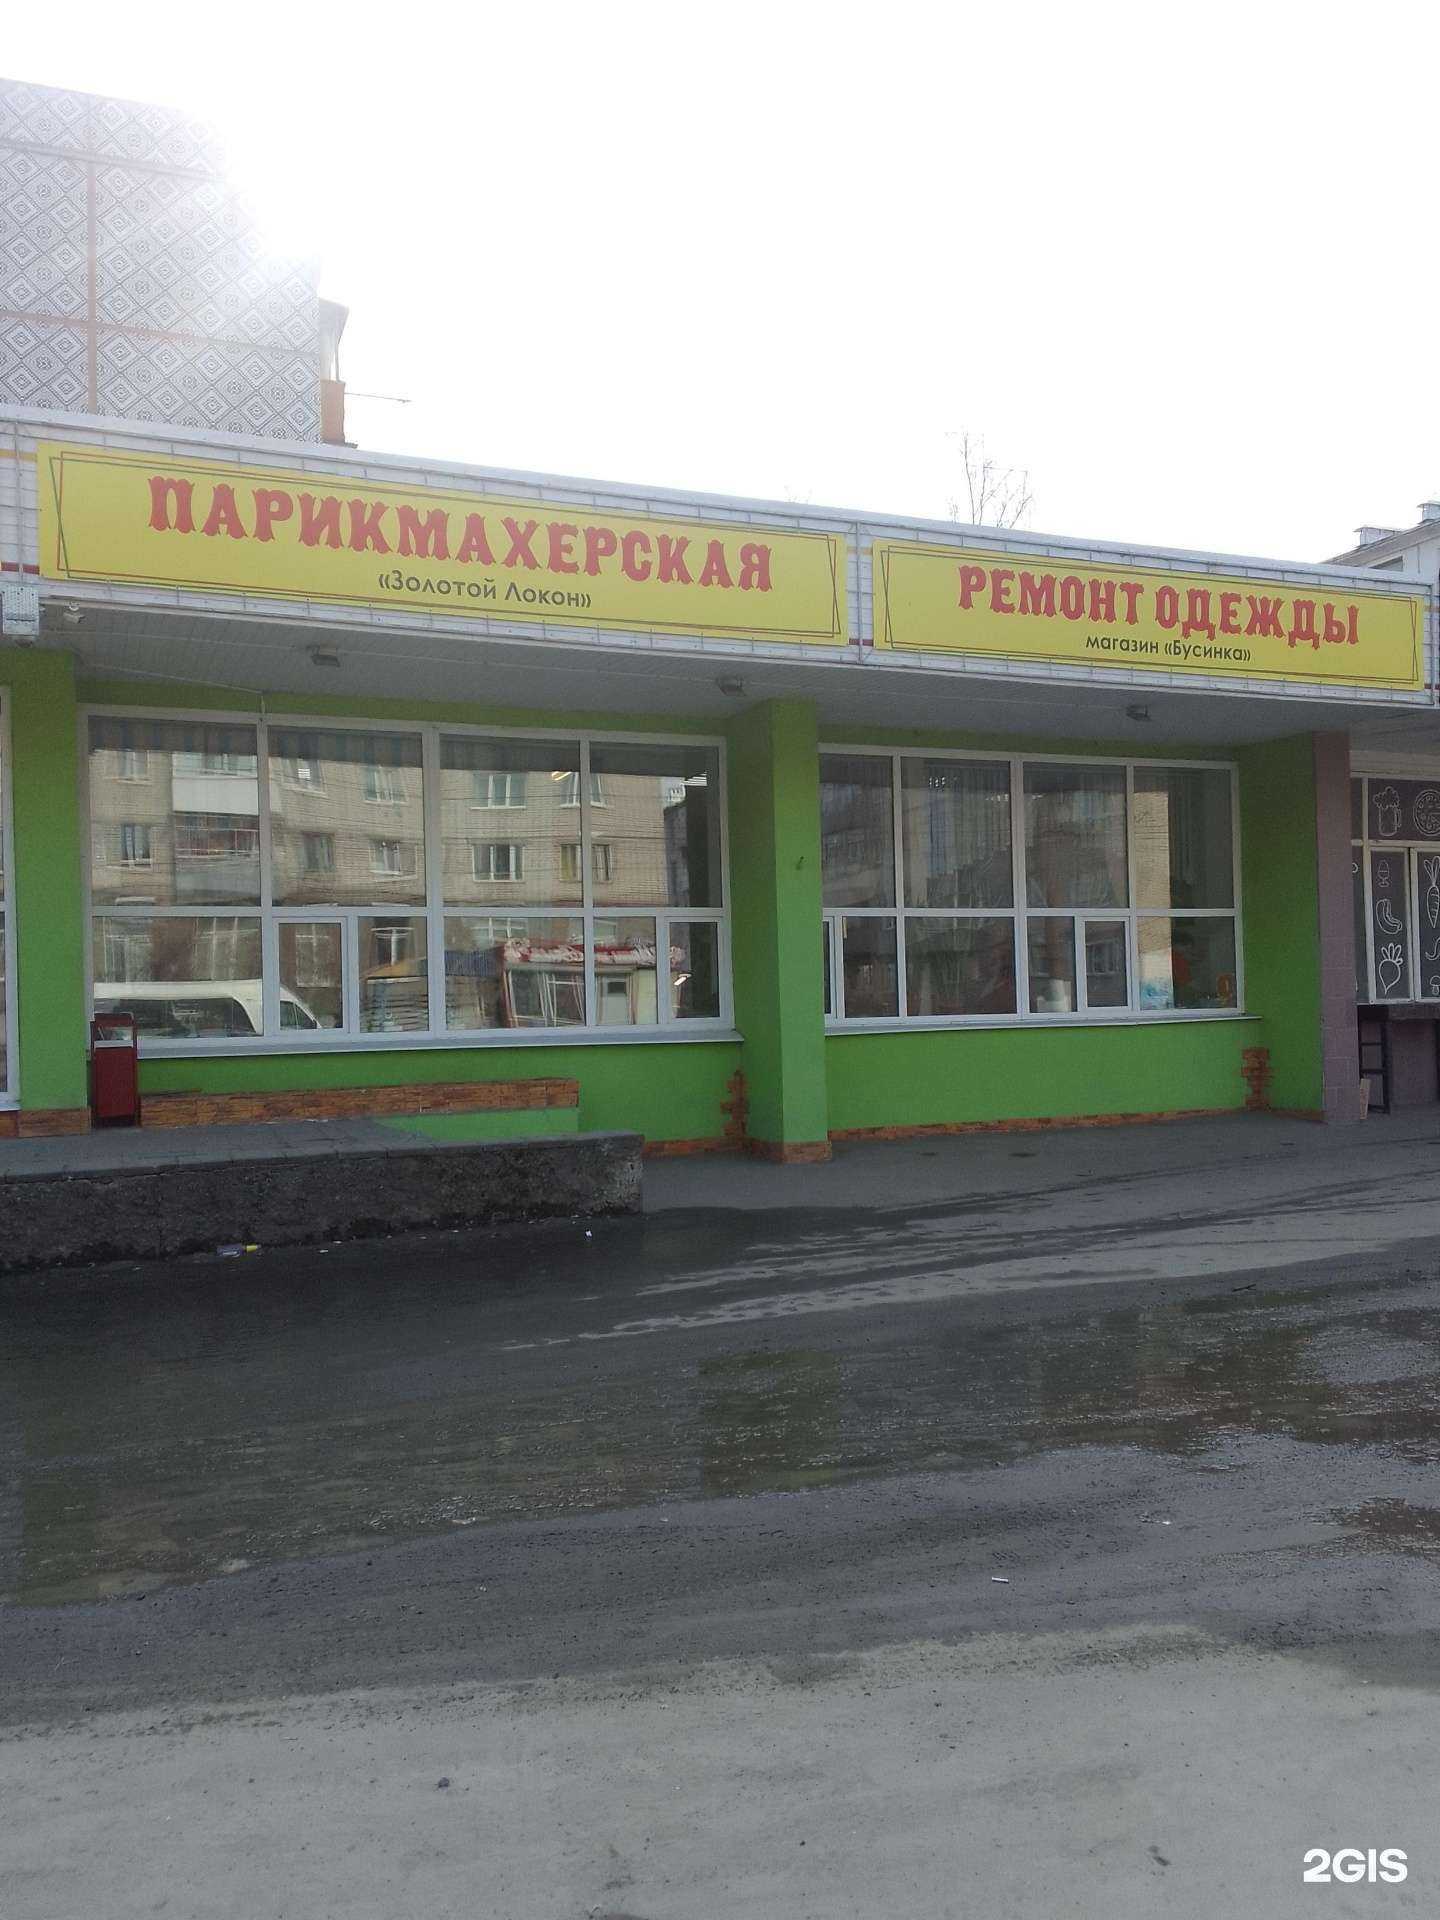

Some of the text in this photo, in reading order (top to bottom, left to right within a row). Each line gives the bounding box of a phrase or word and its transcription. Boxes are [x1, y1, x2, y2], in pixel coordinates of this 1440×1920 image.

[147, 475, 774, 593] ПАРИКМАХЕРСКАЯ
[378, 570, 592, 609] «Золотой Локон»
[958, 564, 1360, 650] РЕМОНТ ОДЕЖДЫ
[1085, 635, 1251, 662] магазин «Бусинка»
